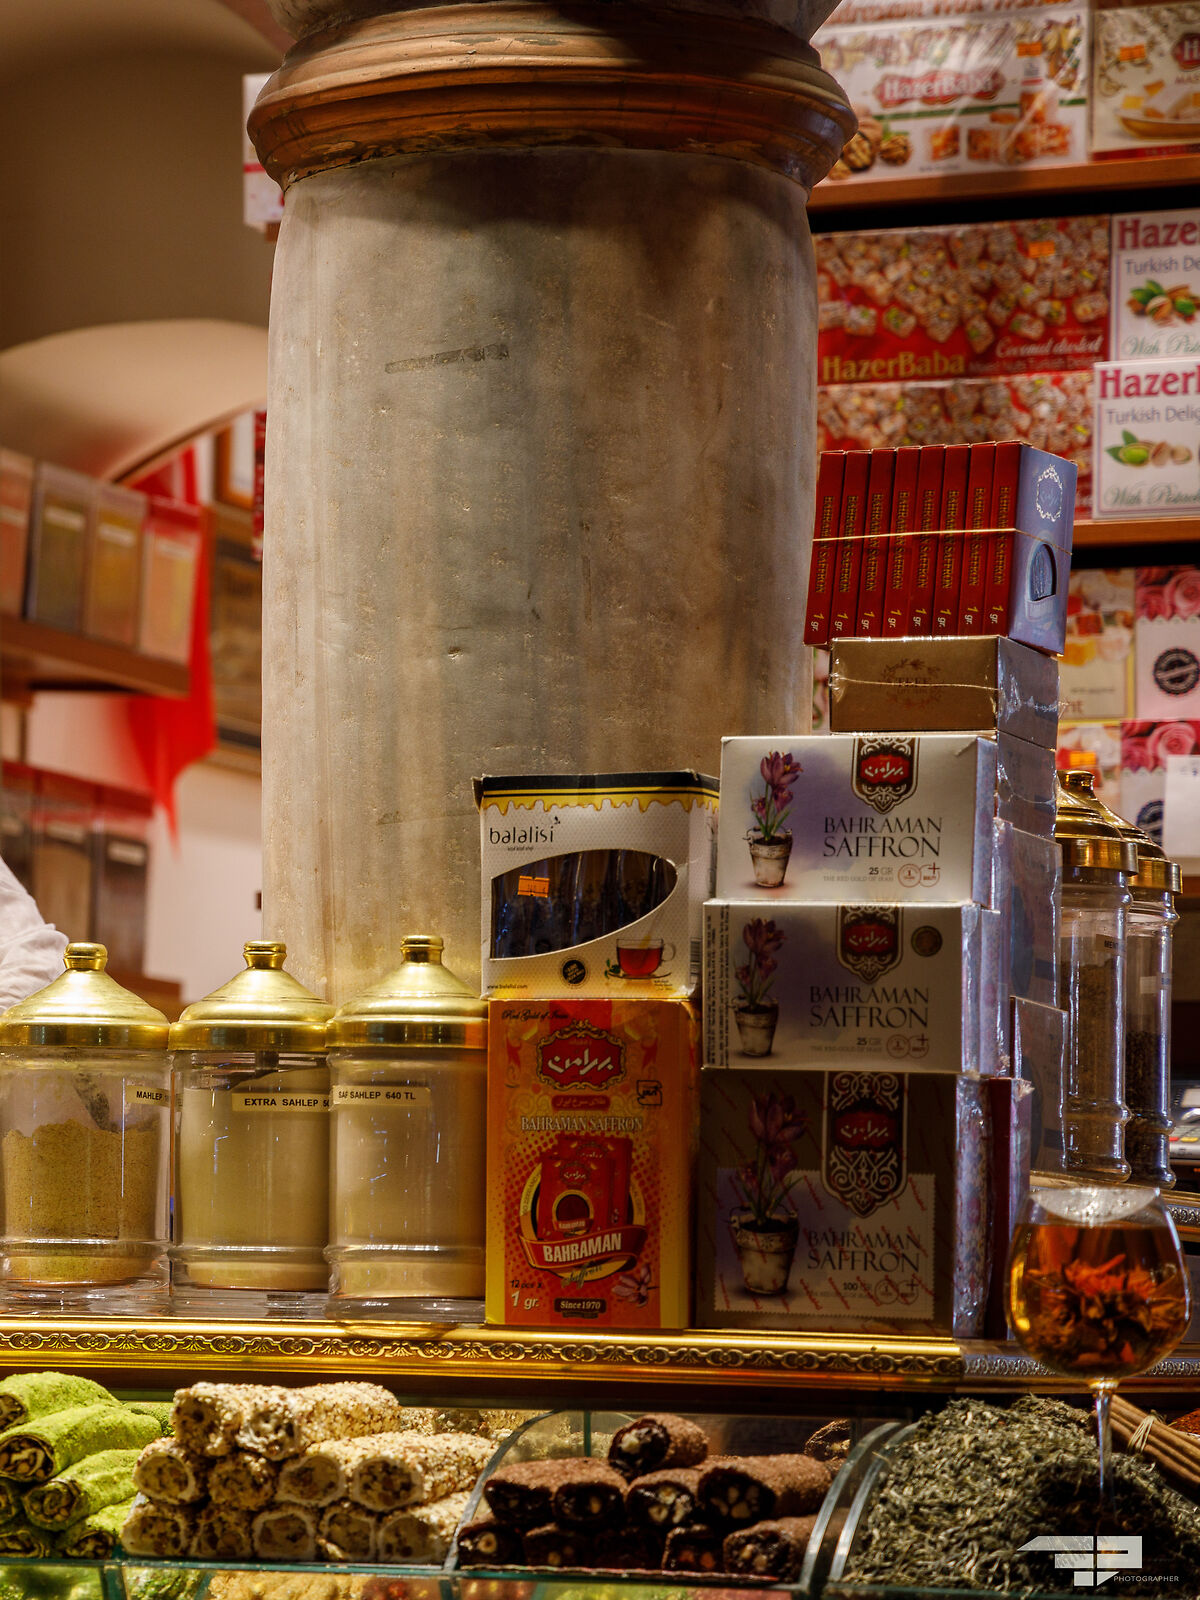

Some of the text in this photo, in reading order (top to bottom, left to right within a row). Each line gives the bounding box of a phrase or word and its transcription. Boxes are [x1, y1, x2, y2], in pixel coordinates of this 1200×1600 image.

[821, 351, 965, 382] HazerBaba
[1100, 366, 1200, 398] Hazer
[824, 817, 942, 834] BAHRAMAN
[489, 826, 554, 844] balalisi
[823, 836, 941, 857] SAFFRON
[868, 867, 879, 875] 25
[810, 986, 929, 1004] BAHRAMAN
[810, 1007, 928, 1028] SAFFRON
[244, 1098, 319, 1108] EXTRA SAHLEP
[349, 1091, 381, 1100] SAHLEP
[385, 1091, 401, 1100] 640
[404, 1091, 416, 1100] TL
[521, 1116, 643, 1131] BAHRAMAN SAFFRON
[543, 1232, 622, 1263] BAHRAMAN
[807, 1231, 921, 1249] BAHRAMAN
[807, 1252, 920, 1273] SAFFRON
[511, 1291, 540, 1310] 1 gr.
